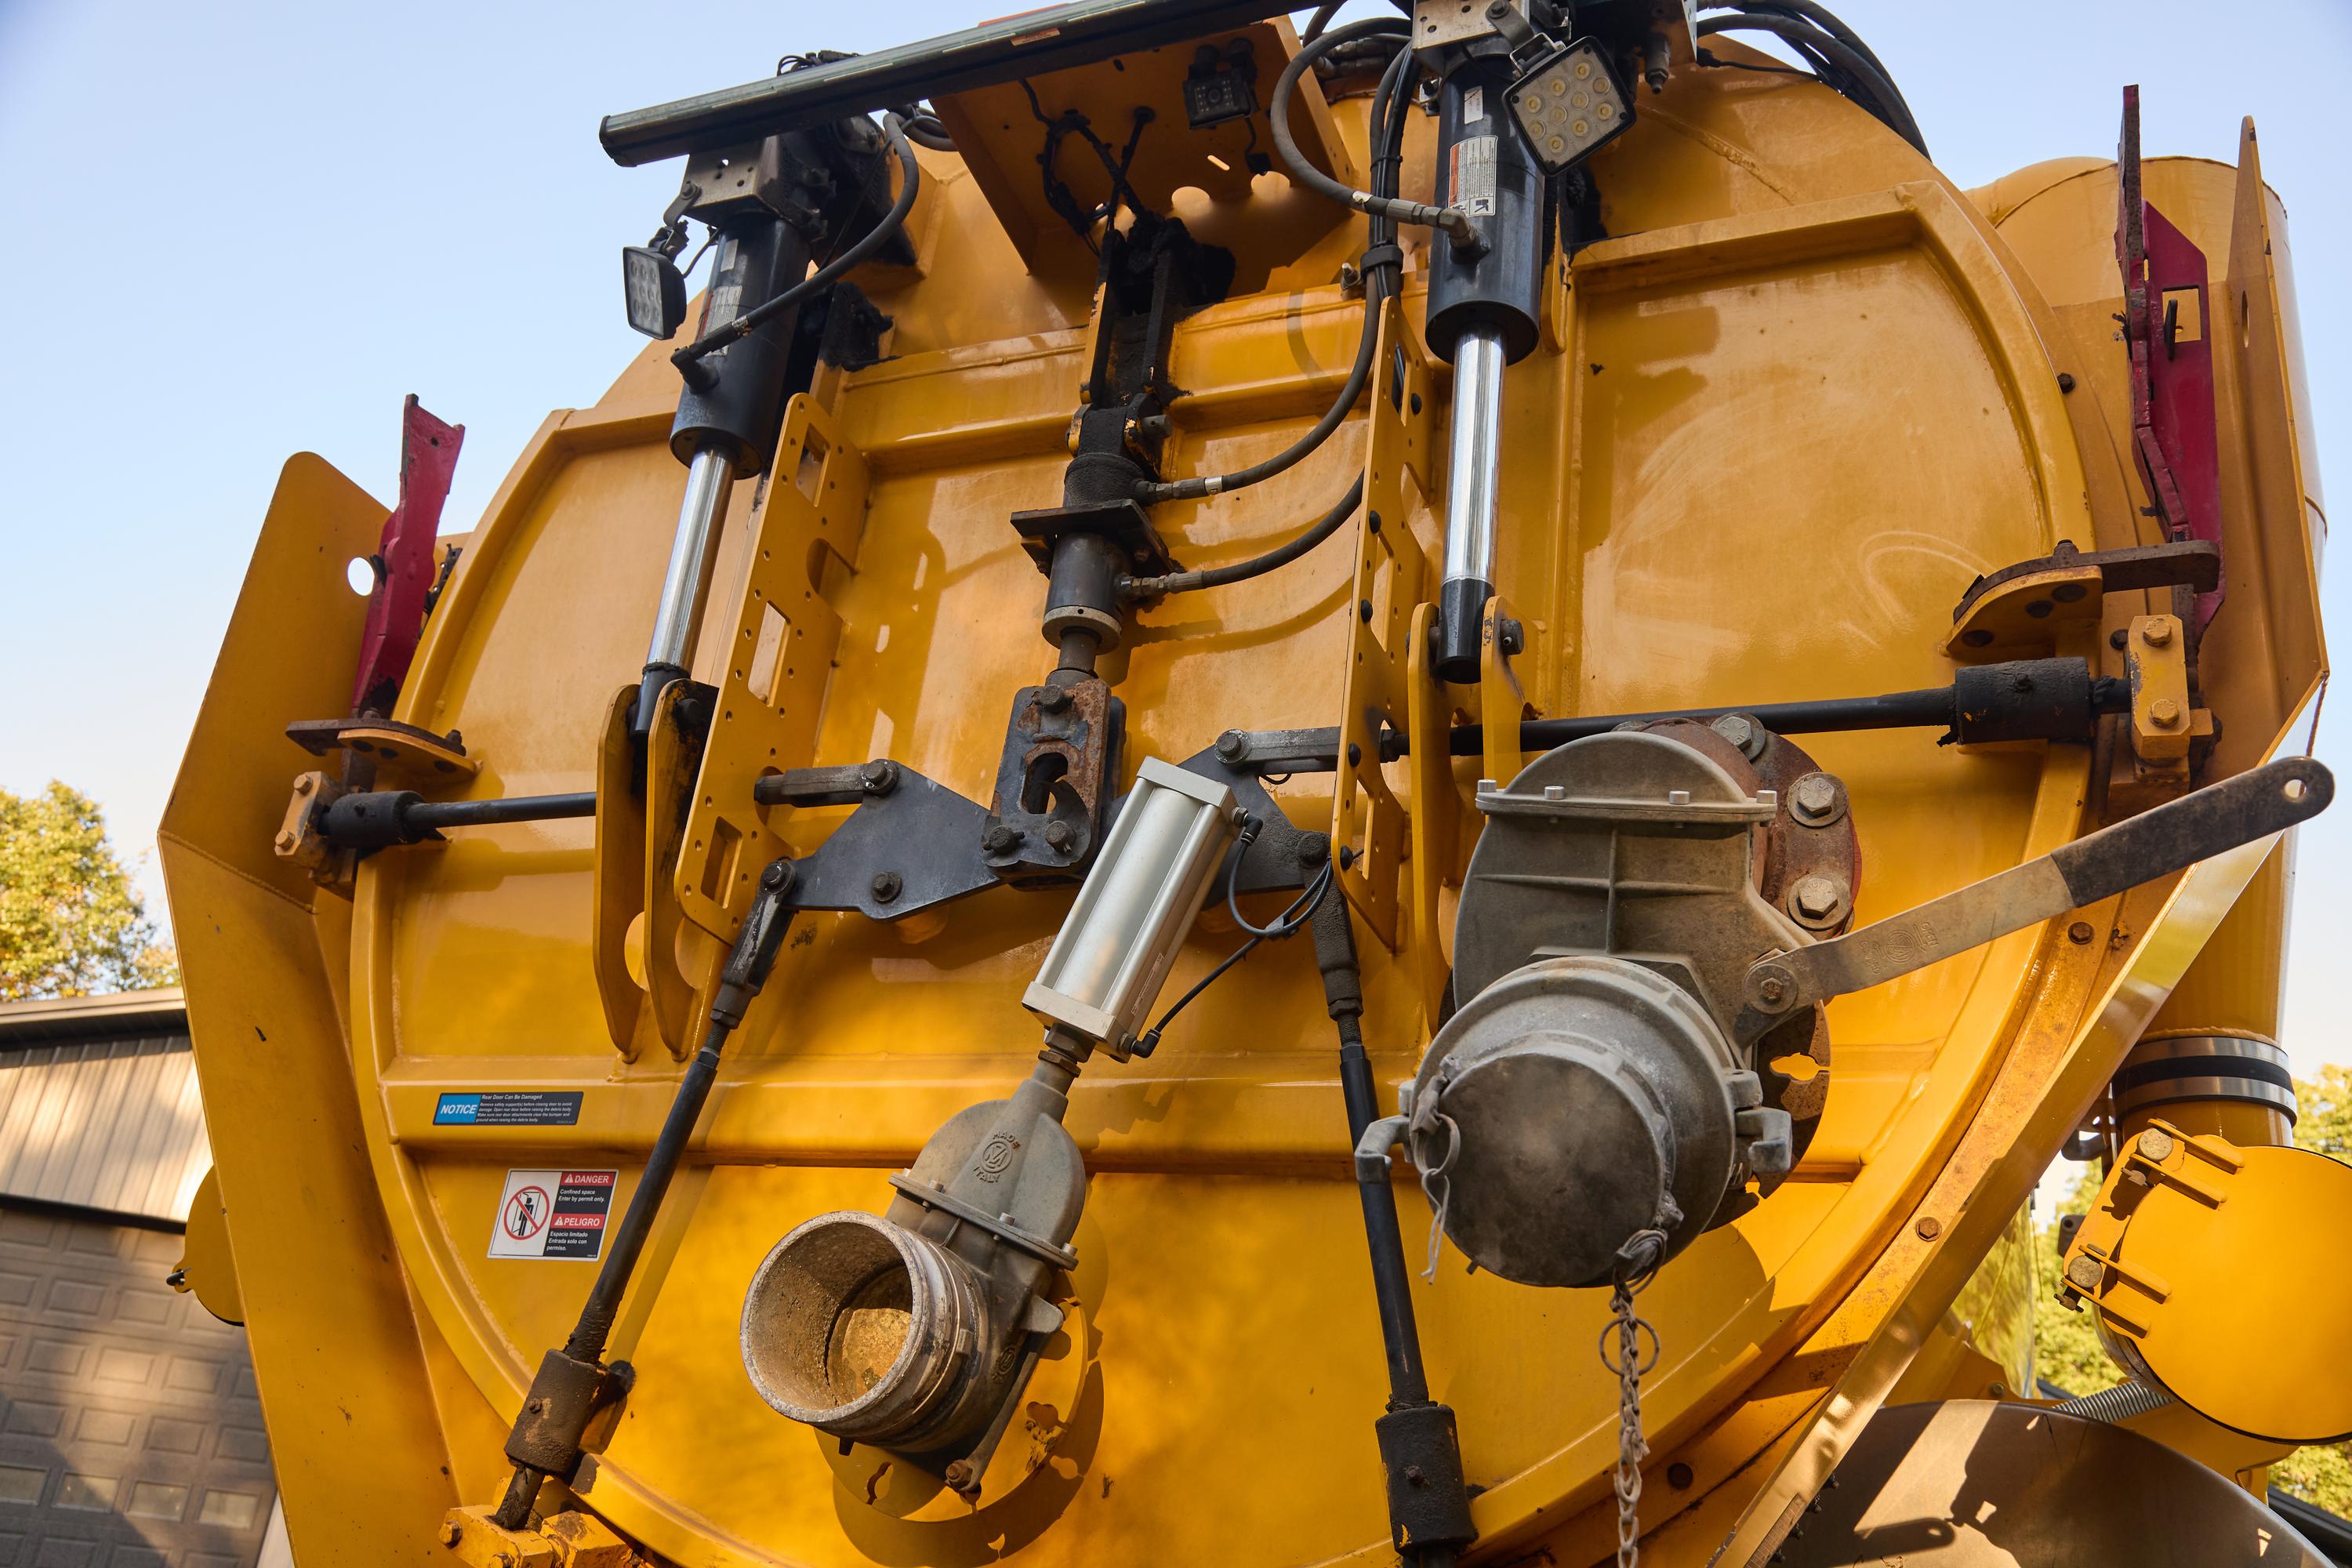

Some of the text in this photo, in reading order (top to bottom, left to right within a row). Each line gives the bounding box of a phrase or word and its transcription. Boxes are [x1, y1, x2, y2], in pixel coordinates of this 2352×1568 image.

[1921, 922, 1939, 948] OPEN
[441, 1104, 477, 1114] NOTICE
[575, 1175, 609, 1184] DANGER
[973, 1166, 1001, 1183] ITALY
[564, 1218, 601, 1226] PELIGRO
